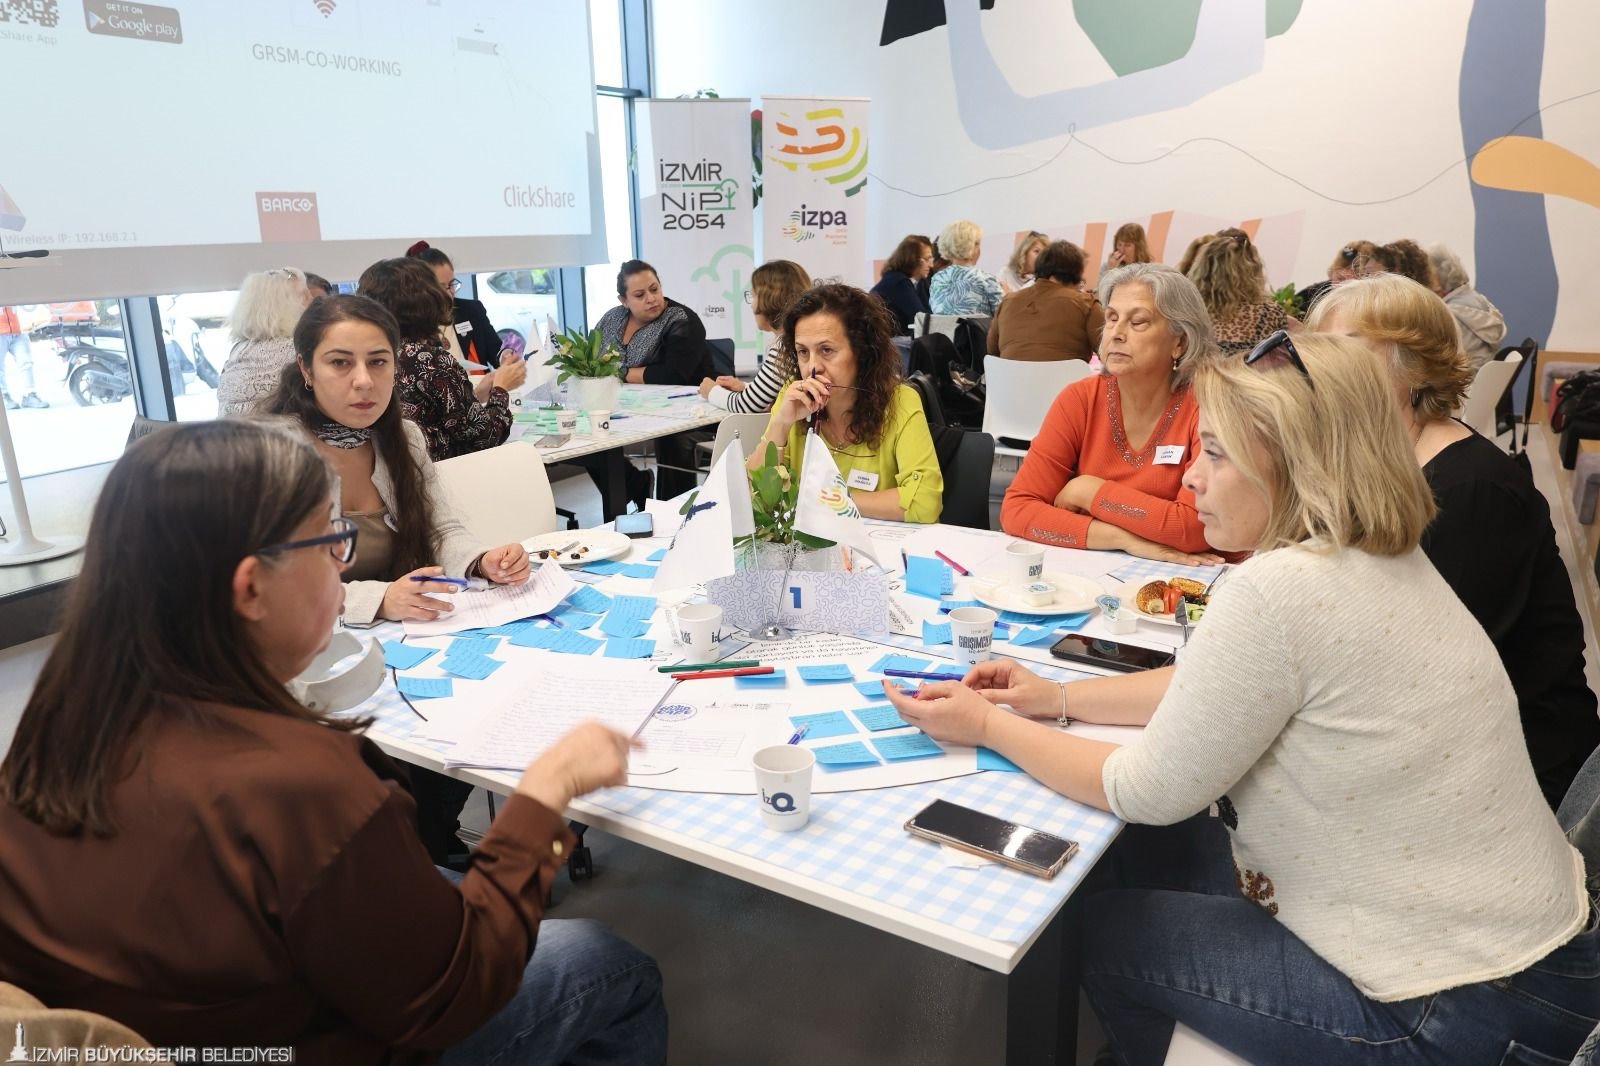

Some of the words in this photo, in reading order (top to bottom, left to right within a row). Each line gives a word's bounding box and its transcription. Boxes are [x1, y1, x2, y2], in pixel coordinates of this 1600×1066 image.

[106, 3, 120, 12] GET
[122, 5, 129, 13] IT
[108, 16, 152, 36] Google
[155, 23, 178, 38] play
[252, 43, 401, 77] GRSM-CO-WORKING
[660, 158, 722, 182] İZMİR
[262, 198, 313, 212] BARCO
[503, 184, 575, 208] ClickShare
[663, 213, 726, 231] 2054
[801, 203, 848, 230] izpa
[789, 586, 801, 608] 1
